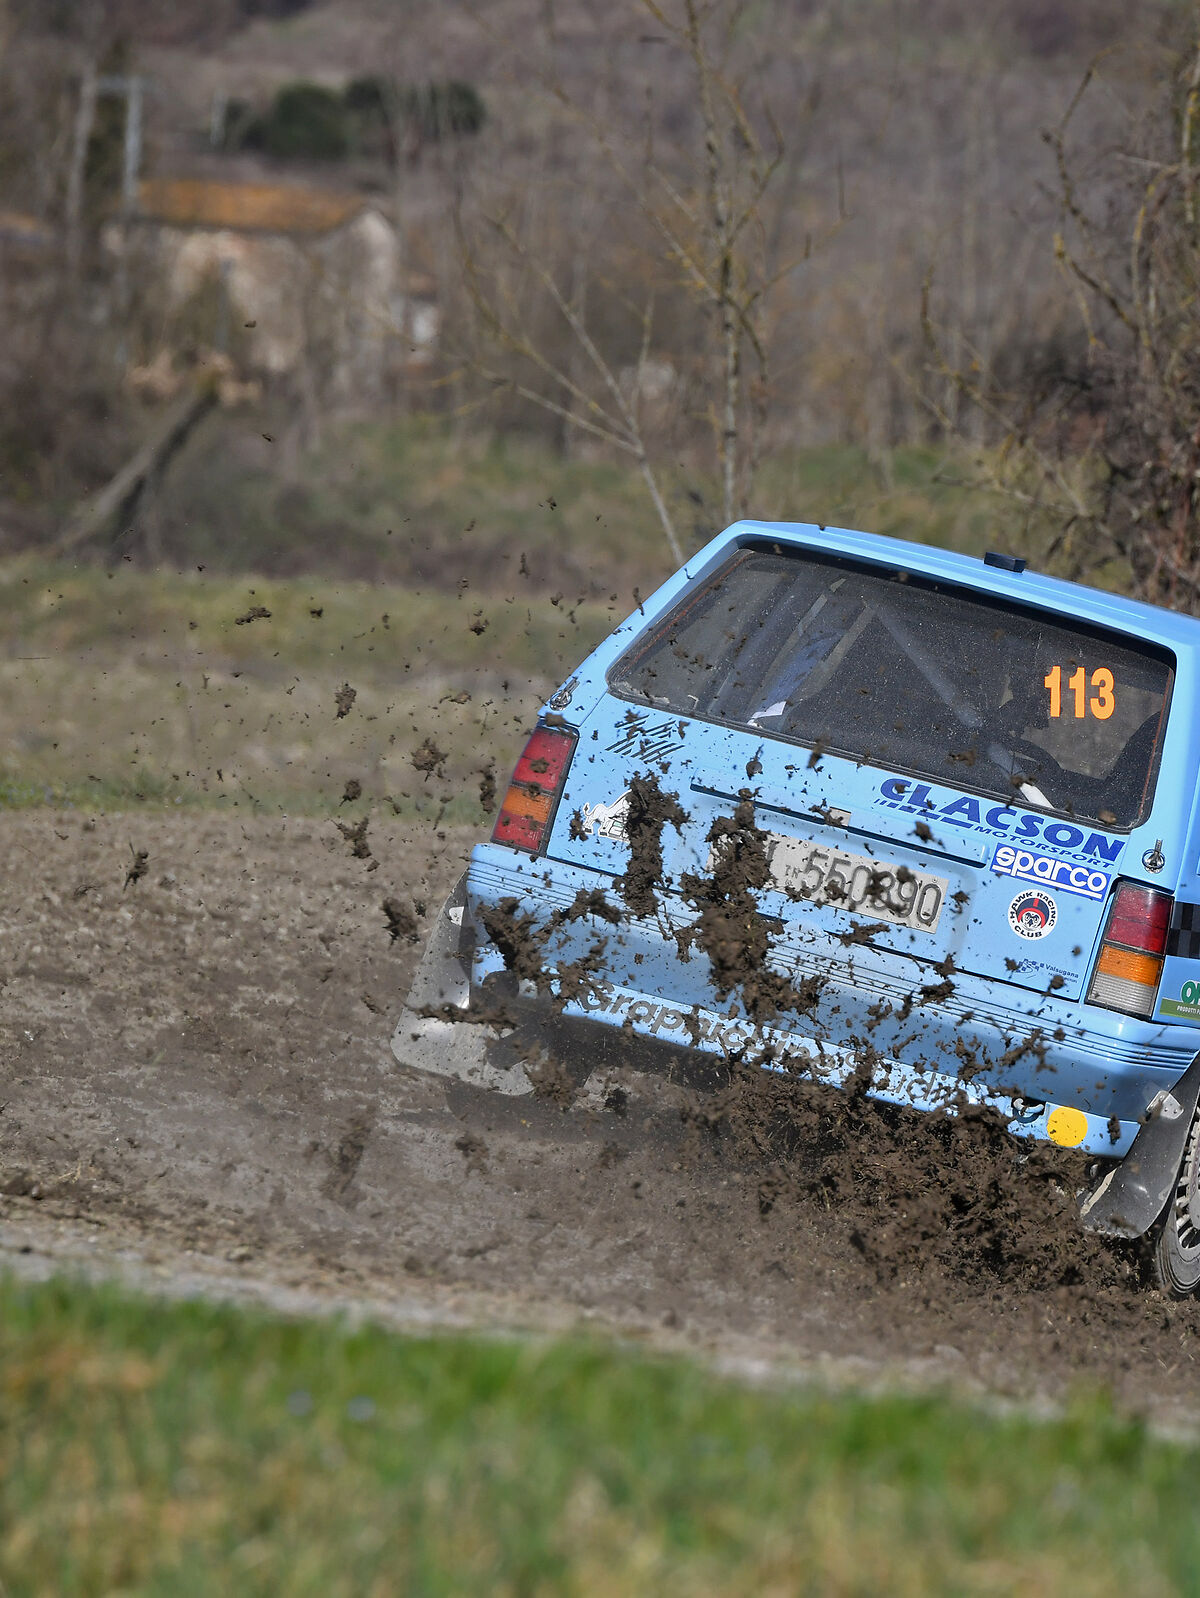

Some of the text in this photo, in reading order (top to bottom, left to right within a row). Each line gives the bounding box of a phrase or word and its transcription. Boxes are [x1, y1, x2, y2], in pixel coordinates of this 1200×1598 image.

[1044, 665, 1116, 720] 113
[880, 778, 1126, 862] CLACSON
[974, 825, 1115, 869] MOTORSPORT
[995, 846, 1108, 893] sparco
[1010, 891, 1056, 927] HAWK RACING
[1014, 925, 1042, 938] CLUB
[1045, 963, 1079, 979] Valsugana
